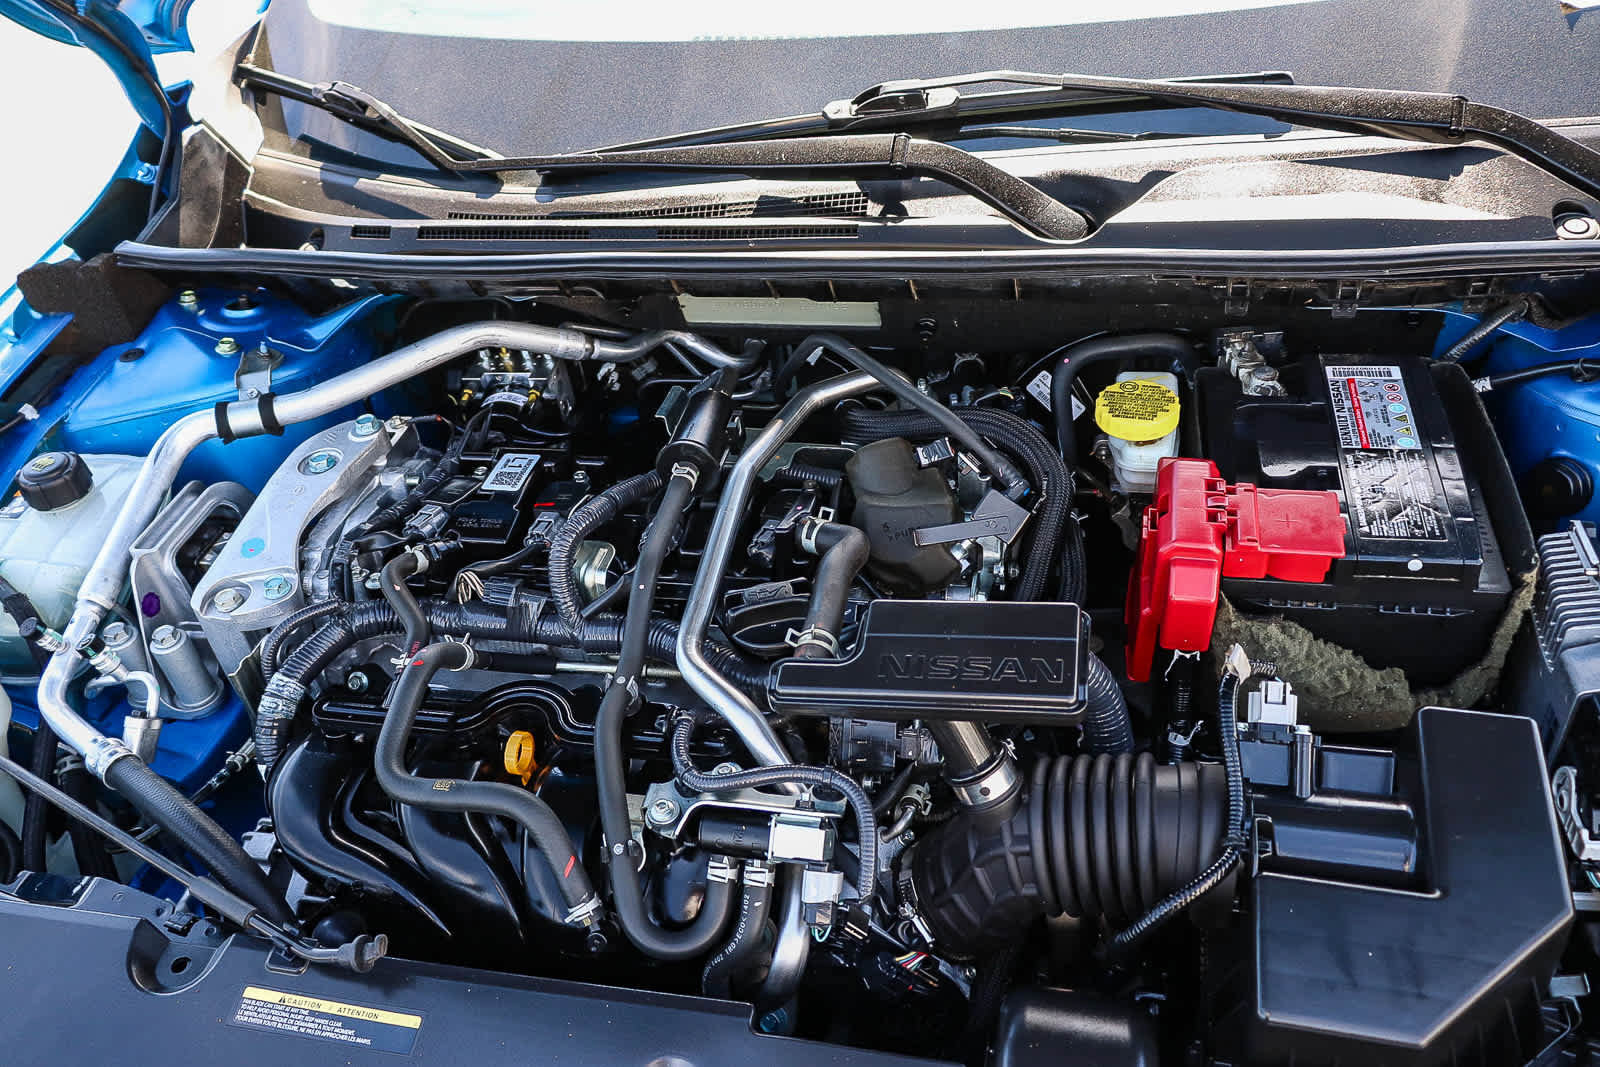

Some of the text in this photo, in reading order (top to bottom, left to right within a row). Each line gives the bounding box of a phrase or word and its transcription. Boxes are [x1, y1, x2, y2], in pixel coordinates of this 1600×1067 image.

[1330, 380, 1347, 413] NISSAN
[1336, 414, 1354, 446] RENAULT
[878, 653, 1065, 684] NISSAN
[287, 997, 380, 1020] CAUTION ATTENTION
